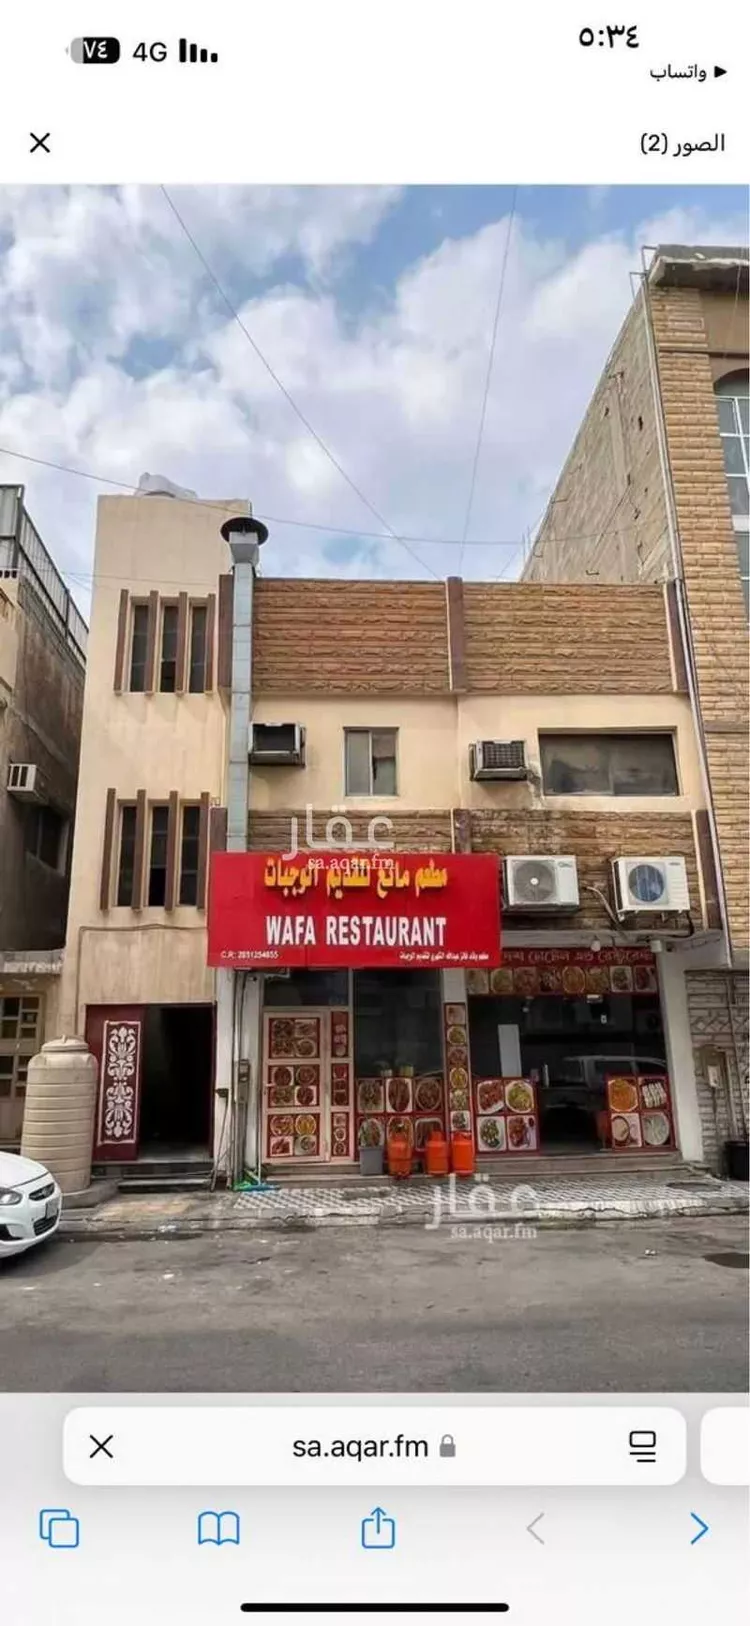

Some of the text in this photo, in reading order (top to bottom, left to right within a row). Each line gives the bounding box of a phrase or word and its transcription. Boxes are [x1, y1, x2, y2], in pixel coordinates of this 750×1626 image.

[132, 41, 167, 63] 4G
[650, 64, 707, 83] واتساب
[640, 133, 726, 156] الصور (2)
[415, 859, 448, 898] مطعم
[265, 915, 448, 947] WAFA RESTAURANT
[293, 1433, 428, 1462] sa.aqar.fm
